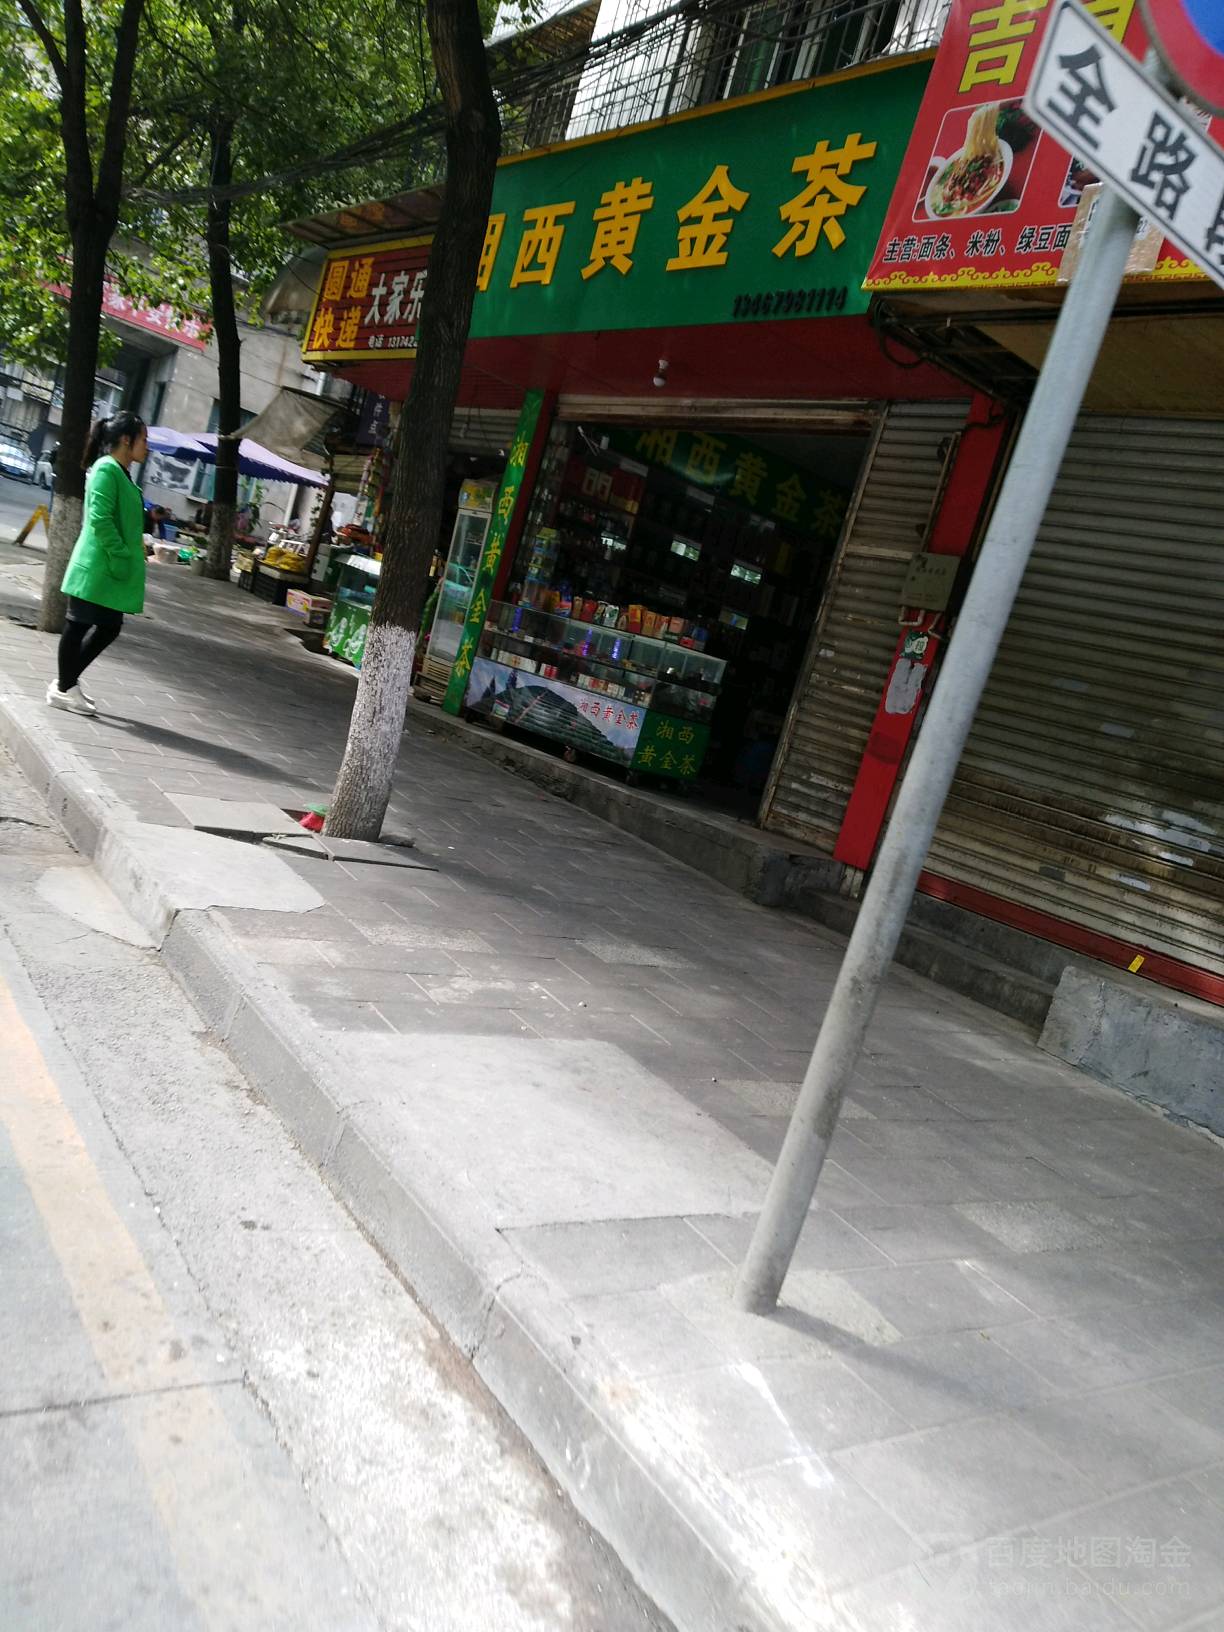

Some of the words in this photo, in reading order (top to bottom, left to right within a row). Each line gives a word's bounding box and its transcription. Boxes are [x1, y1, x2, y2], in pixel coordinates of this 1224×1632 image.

[322, 257, 375, 302] 圆通
[364, 268, 428, 326] 大家乐
[312, 305, 362, 350] 快递
[455, 431, 531, 678] 湘西黄金茶
[576, 697, 640, 731] 湘西黄金茶
[655, 720, 697, 745] 湘西
[636, 746, 698, 776] 黄金茶
